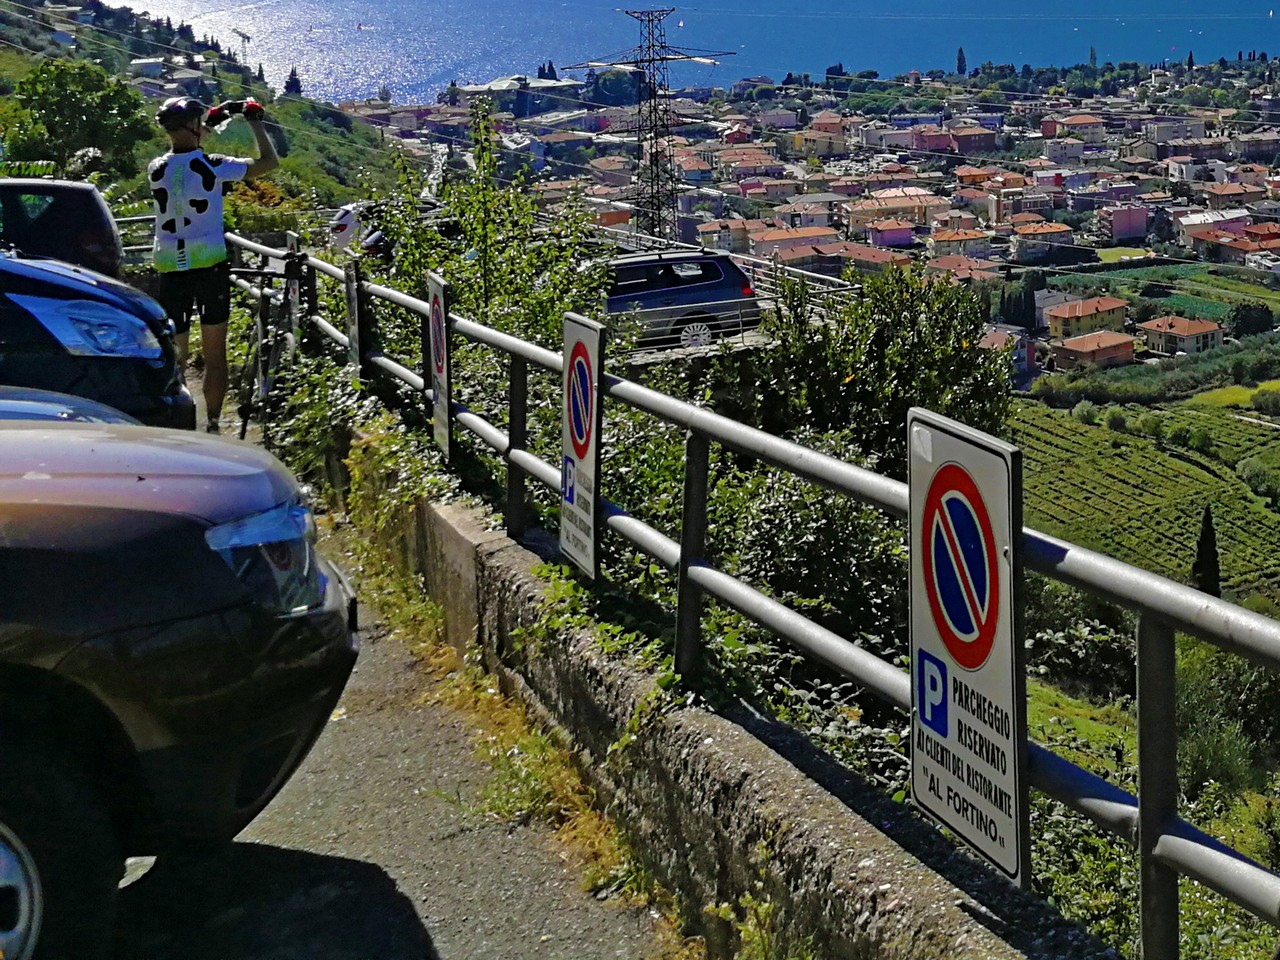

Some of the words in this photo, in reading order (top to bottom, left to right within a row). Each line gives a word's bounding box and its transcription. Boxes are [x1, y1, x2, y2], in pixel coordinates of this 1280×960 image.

[924, 659, 943, 722] P
[952, 676, 1010, 740] PARCHEGGIO
[917, 727, 925, 753] AI
[925, 734, 951, 772] CLIENTI
[952, 753, 965, 783] DEL
[966, 763, 1012, 819] RISTORANTE
[957, 718, 1007, 776] RISERVATO
